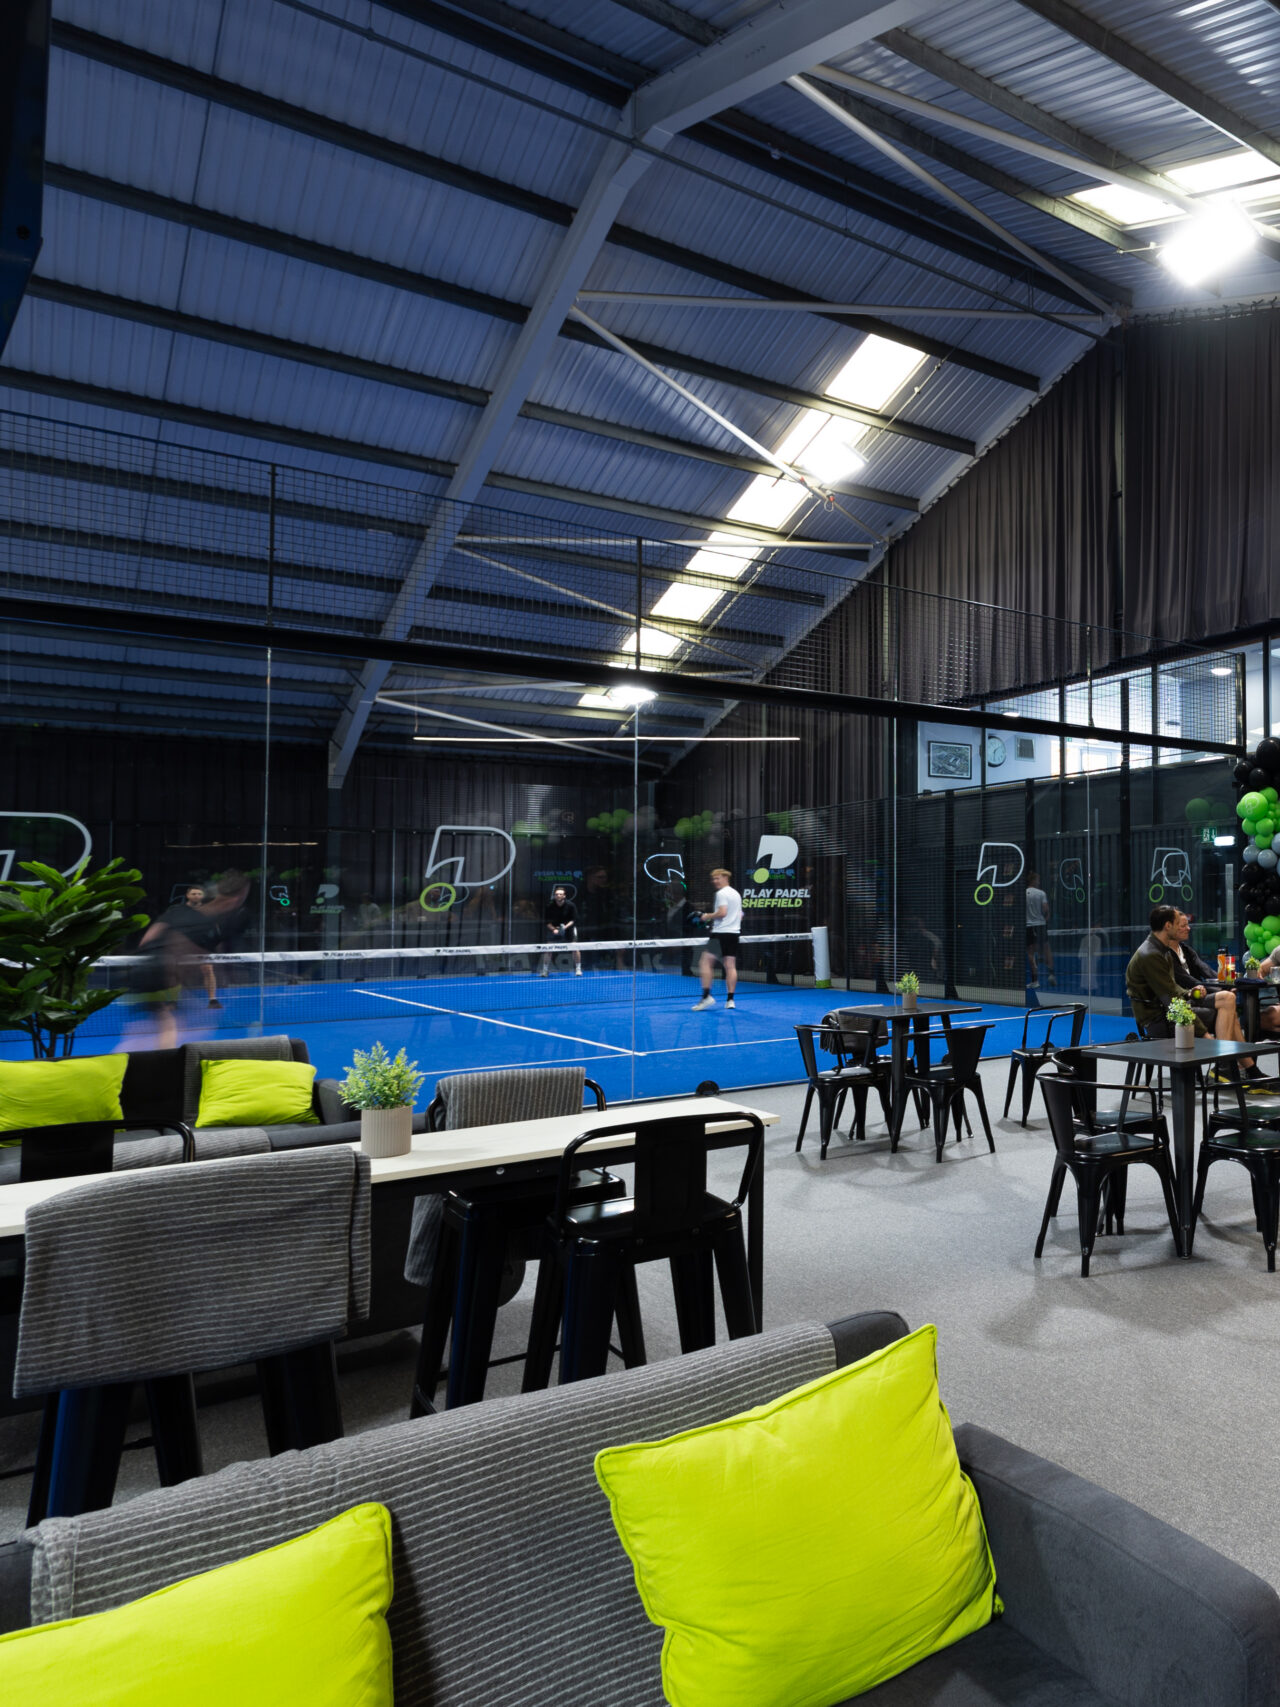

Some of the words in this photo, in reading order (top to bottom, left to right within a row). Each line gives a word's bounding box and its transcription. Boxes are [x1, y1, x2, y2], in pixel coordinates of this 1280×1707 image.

[743, 889, 773, 898] PLAY
[774, 889, 811, 898] PADEL
[742, 899, 803, 908] SHEFFIELD
